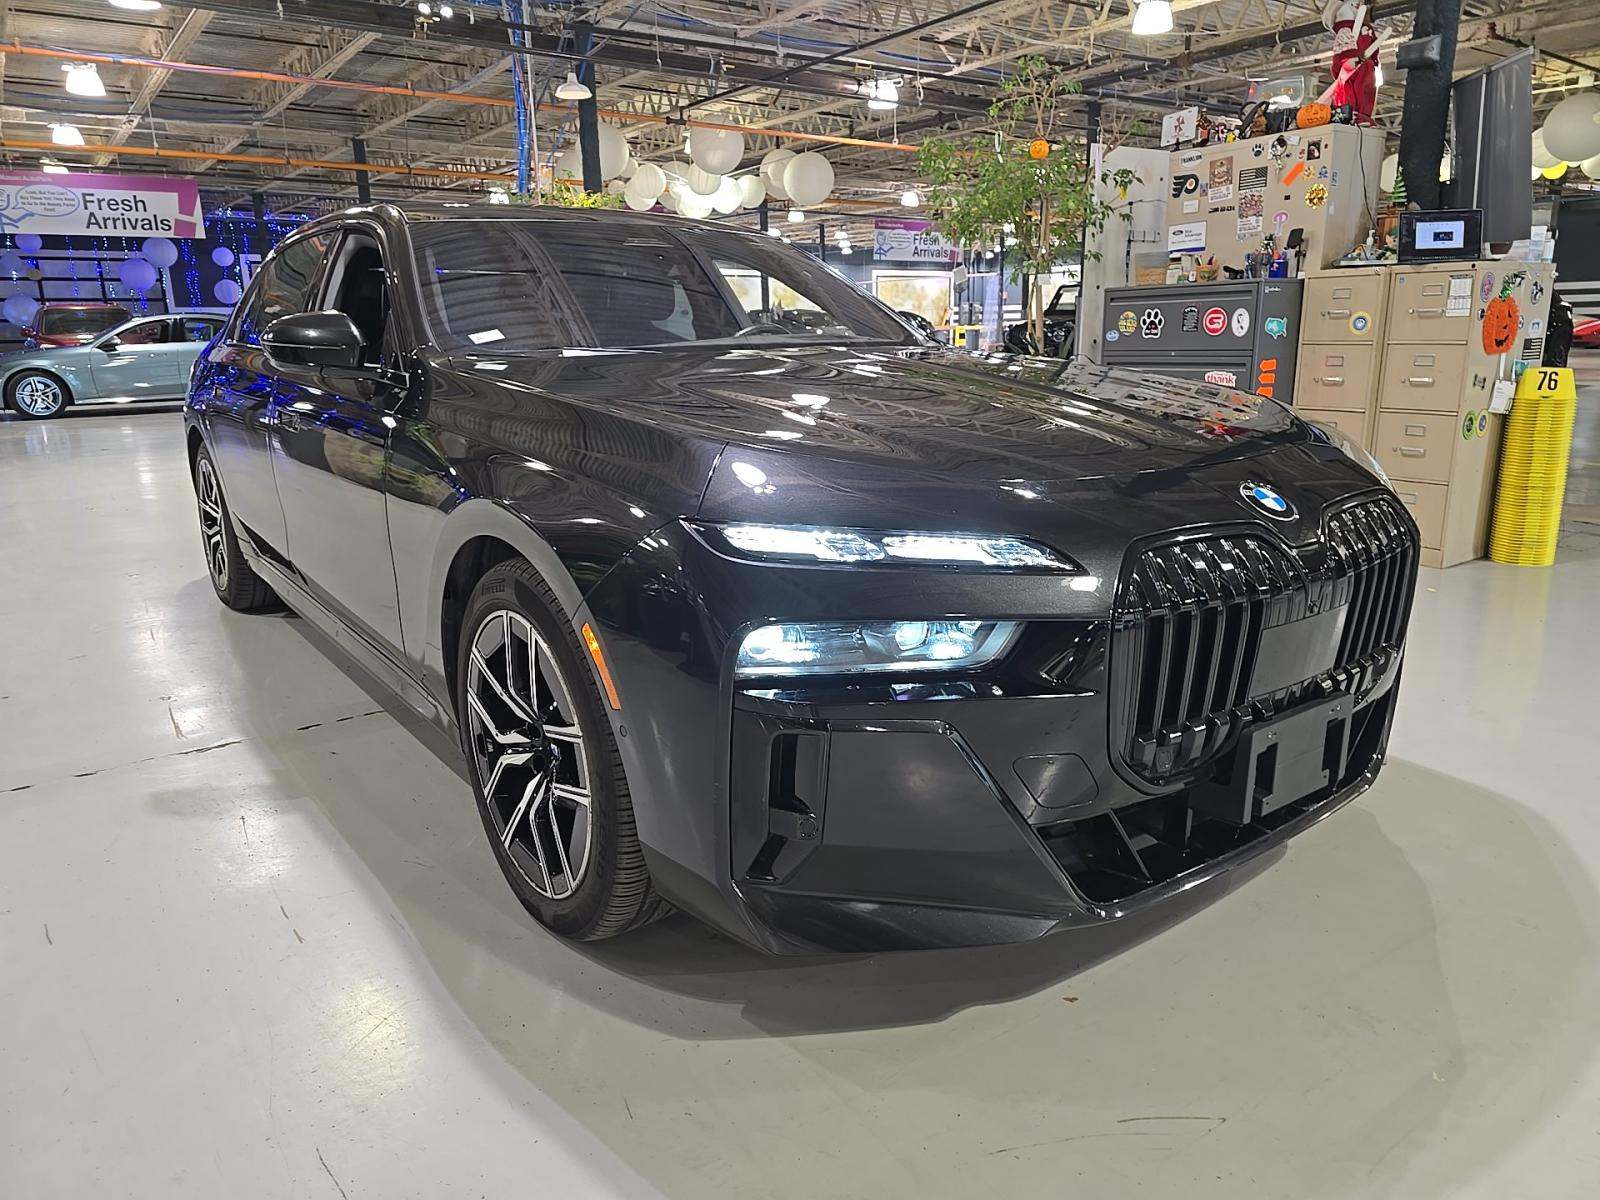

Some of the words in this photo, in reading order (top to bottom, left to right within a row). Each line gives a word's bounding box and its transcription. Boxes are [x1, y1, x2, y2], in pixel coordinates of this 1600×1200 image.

[81, 192, 147, 212] Fresh
[86, 211, 172, 231] Arrivals
[913, 233, 940, 246] Fresh
[912, 246, 949, 258] Arrivals
[1537, 371, 1558, 391] 76
